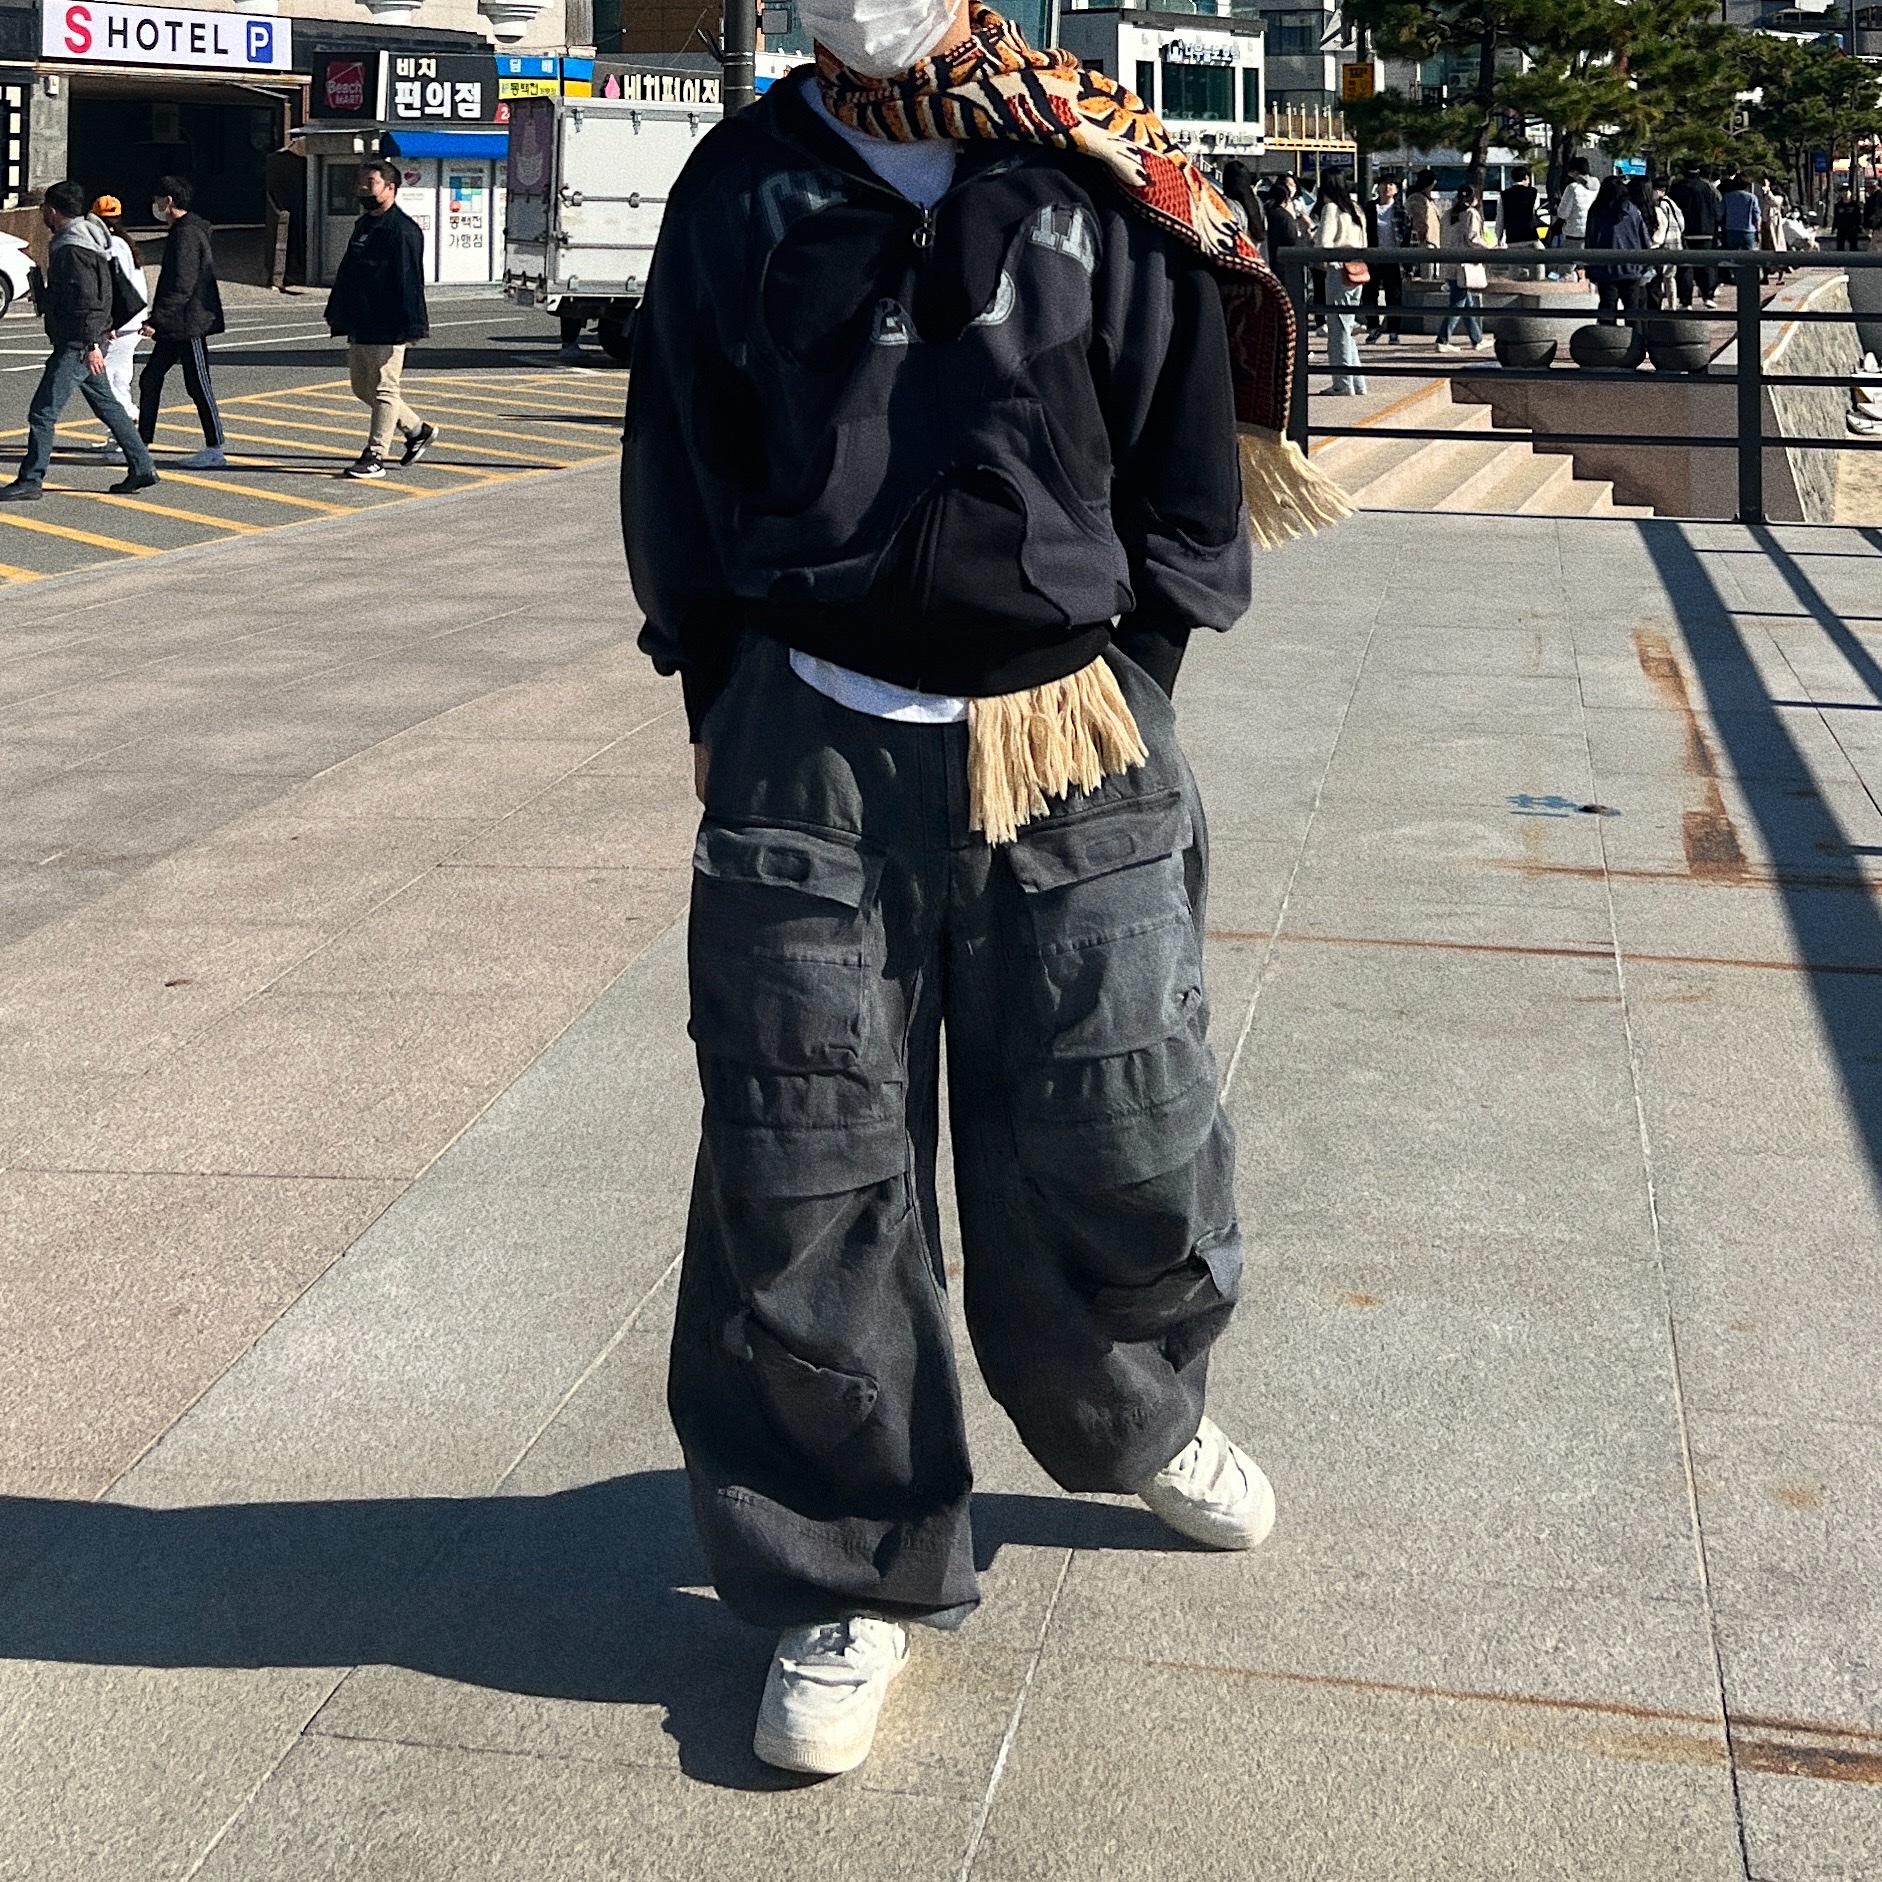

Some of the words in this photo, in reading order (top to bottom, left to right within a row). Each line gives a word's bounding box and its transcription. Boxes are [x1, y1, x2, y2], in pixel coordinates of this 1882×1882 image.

[64, 5, 92, 54] S
[107, 16, 229, 55] HOTEL
[250, 26, 270, 58] P
[396, 57, 437, 79] 비치
[325, 79, 363, 94] Beach
[394, 80, 482, 119] 편의점
[449, 215, 482, 230] 동백전
[448, 233, 483, 249] 가맹점
